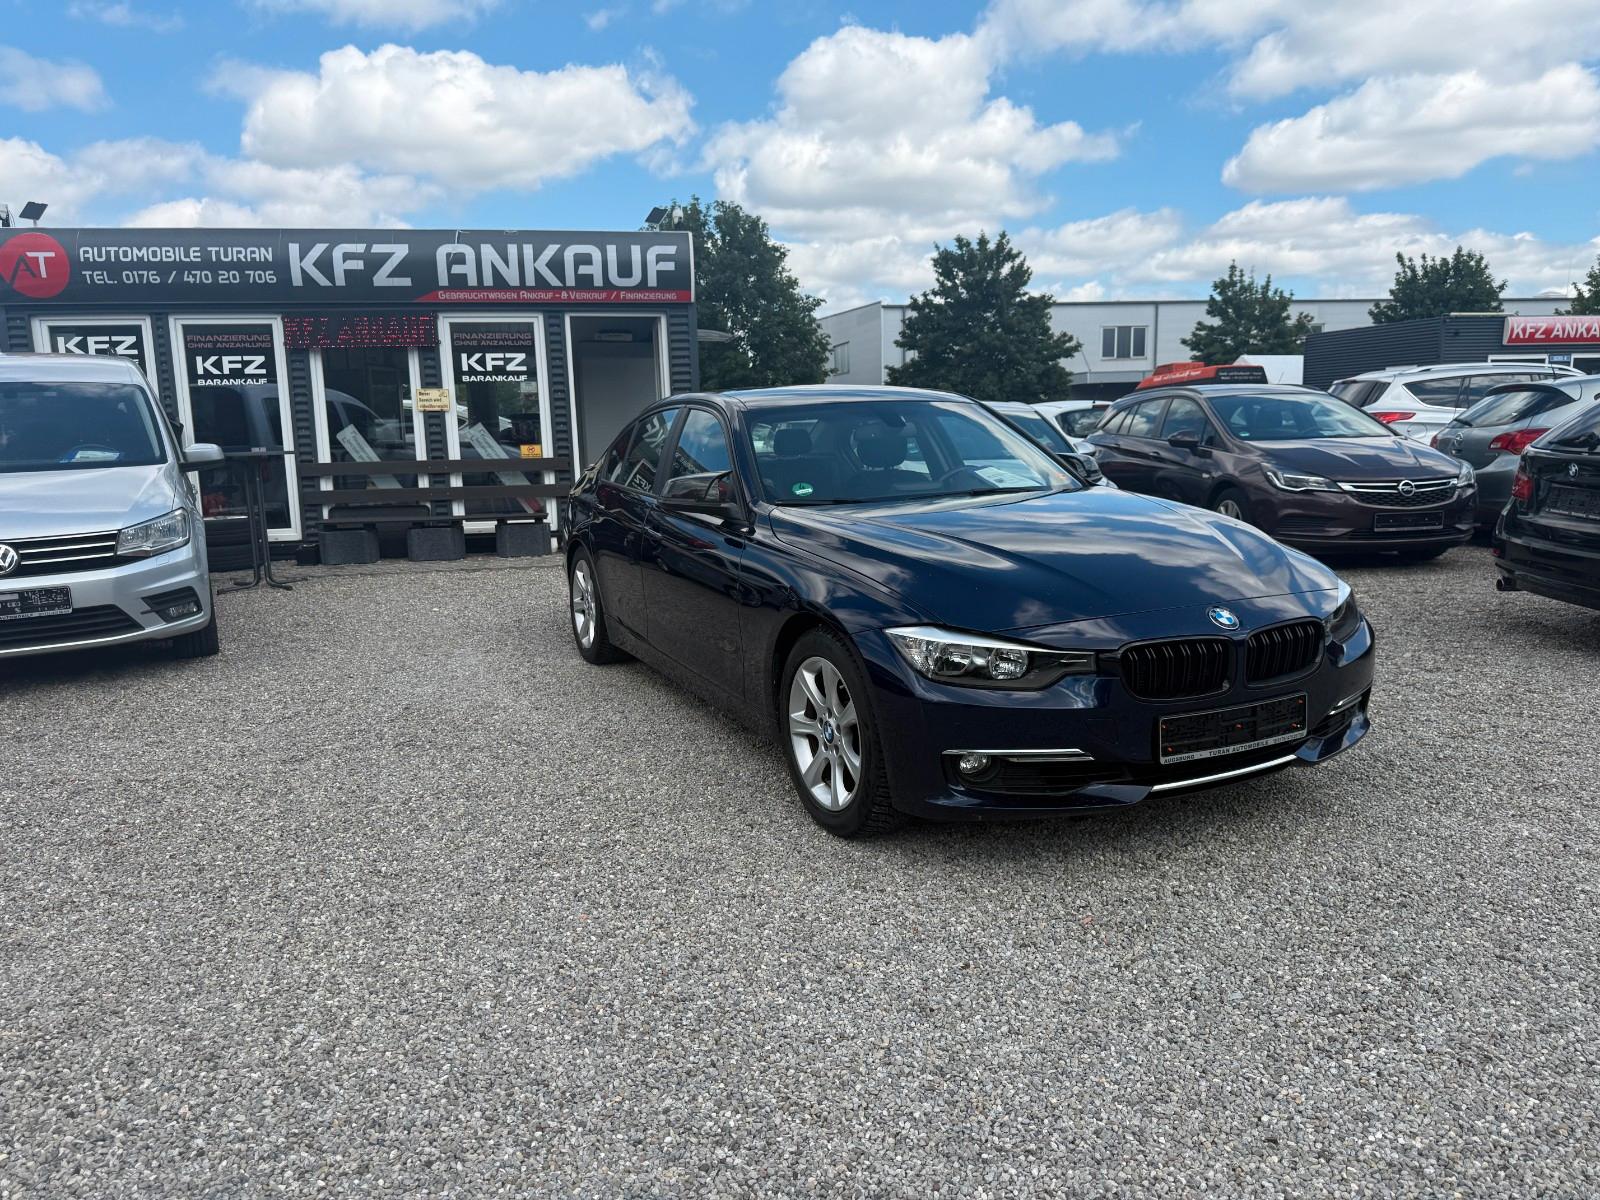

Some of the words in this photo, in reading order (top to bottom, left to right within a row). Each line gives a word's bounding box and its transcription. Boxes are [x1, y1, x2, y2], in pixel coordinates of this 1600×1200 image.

[80, 246, 201, 262] AUTOMOBILE
[207, 246, 273, 262] TURAN
[288, 242, 412, 287] KFZ
[435, 243, 677, 287] ANKAUF
[81, 270, 117, 284] TEL.
[122, 270, 160, 284] 0176
[167, 270, 177, 284] /
[183, 270, 212, 284] 470
[218, 270, 240, 284] 20
[244, 270, 277, 284] 706
[186, 334, 271, 342] FINANZIERUNG
[453, 332, 532, 340] FINANZIERUNG
[1511, 322, 1548, 339] KFZ
[56, 335, 139, 356] KFZ
[195, 355, 267, 375] KFZ
[461, 352, 528, 372] KFZ
[197, 378, 268, 386] BARANKAUF
